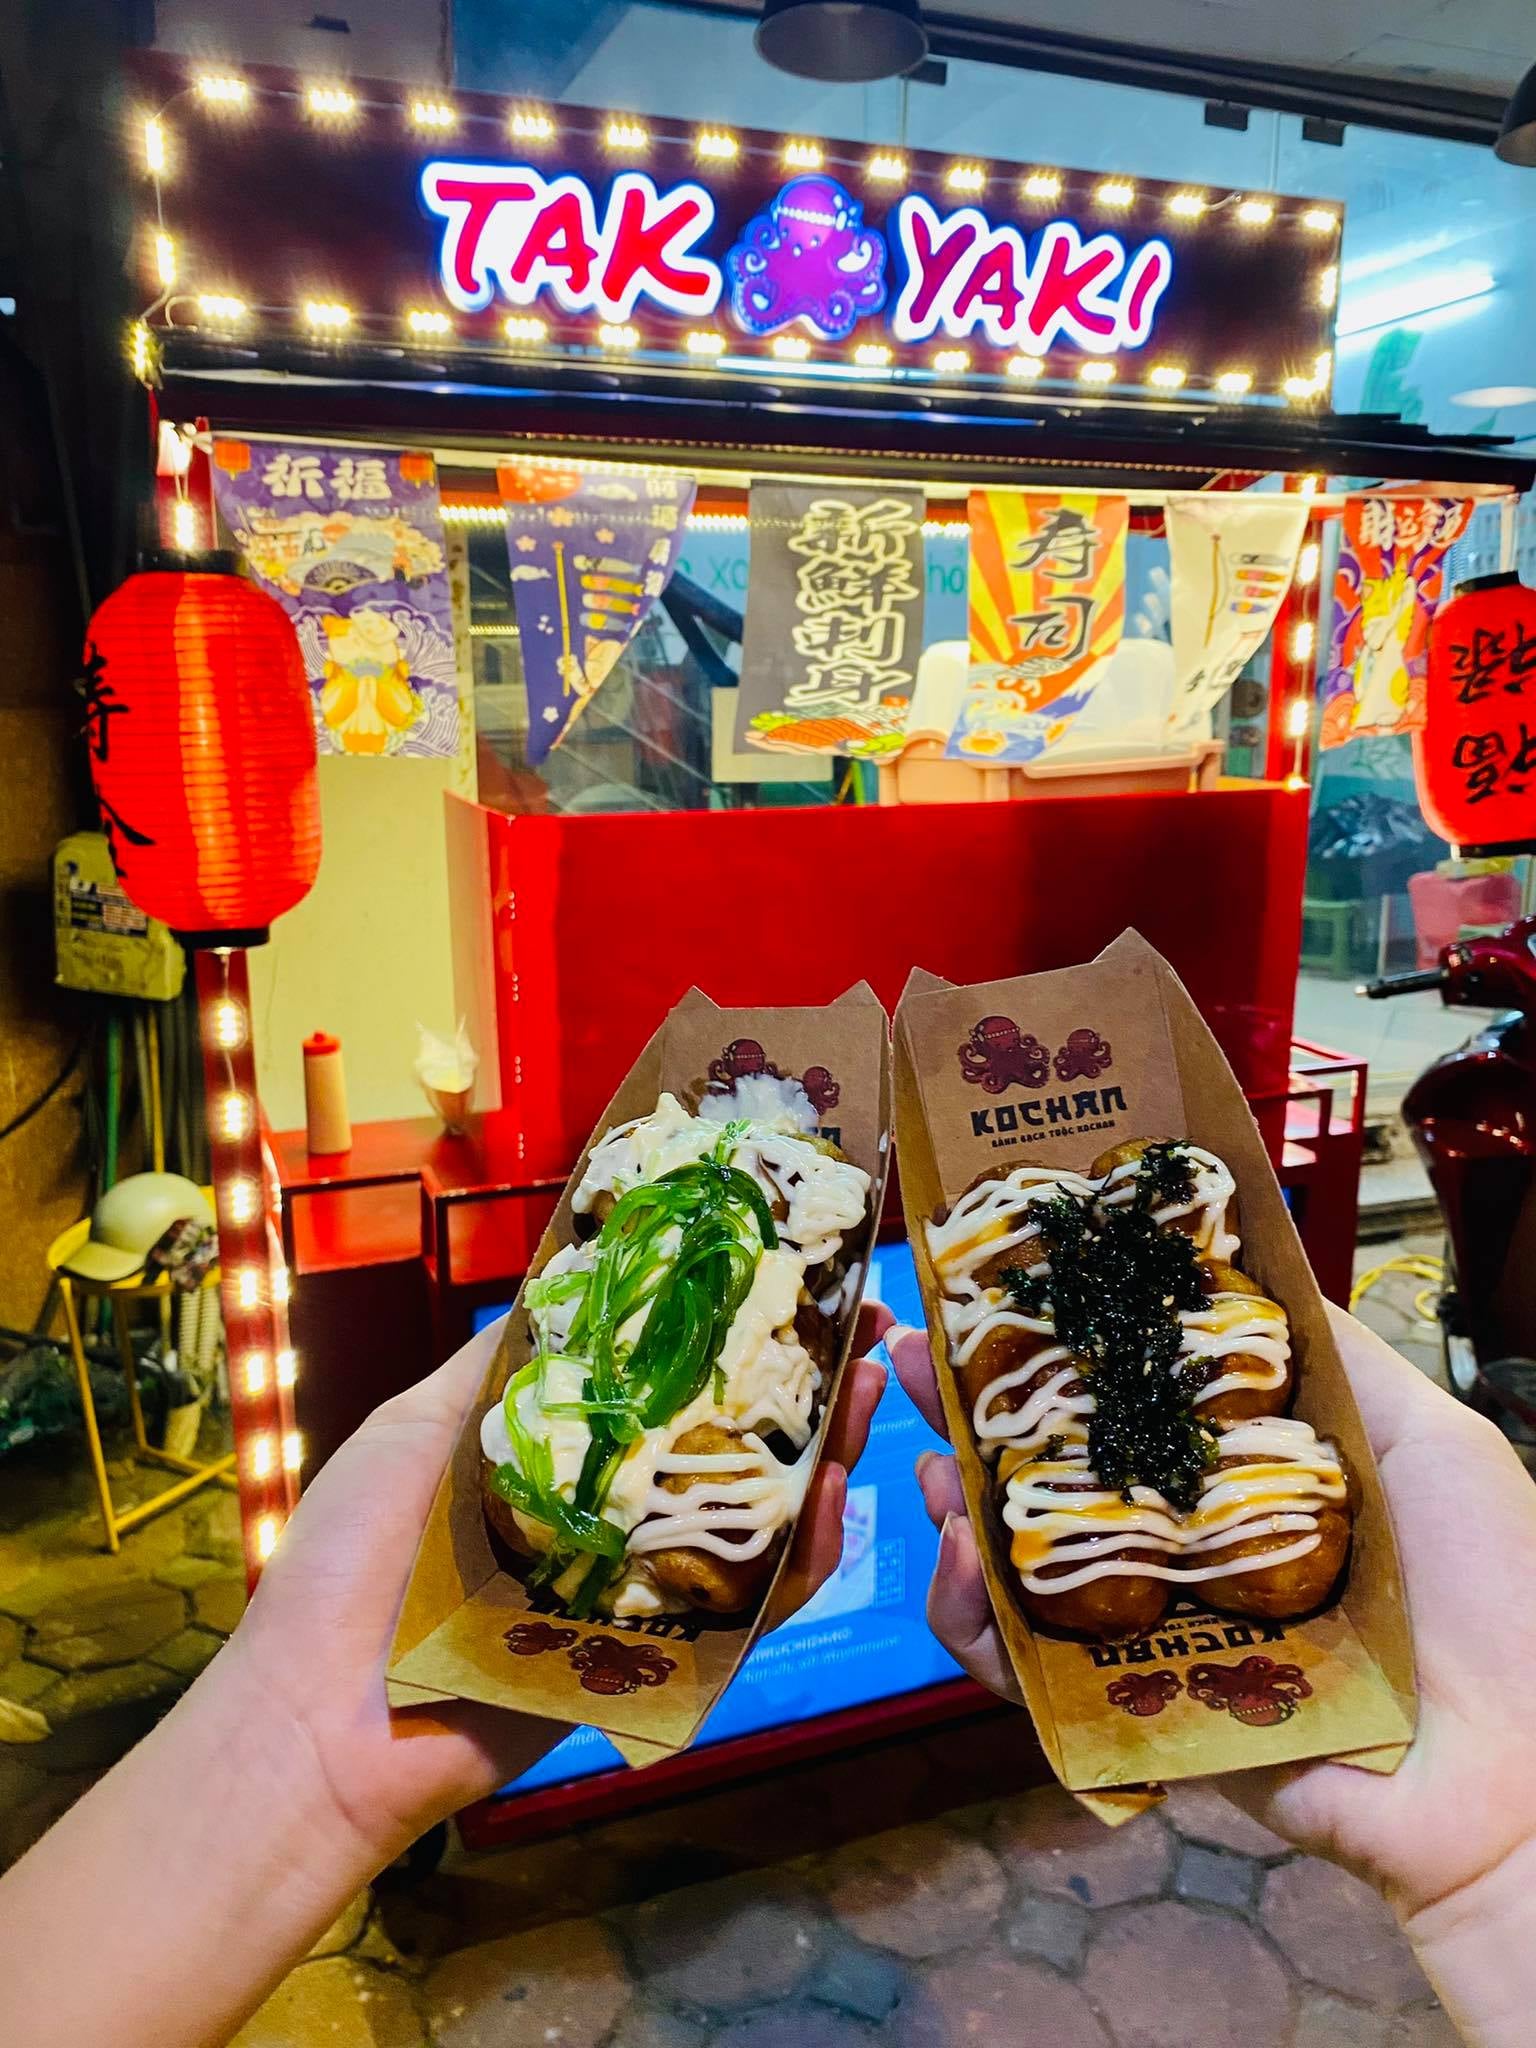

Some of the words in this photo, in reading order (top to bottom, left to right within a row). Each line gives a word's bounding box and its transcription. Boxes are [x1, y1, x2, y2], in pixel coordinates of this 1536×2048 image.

[429, 170, 715, 311] TAK
[900, 203, 1166, 347] YAKI
[261, 453, 393, 501] 祈福
[1011, 507, 1100, 664] 寿司
[970, 1086, 1128, 1137] KOCHAN
